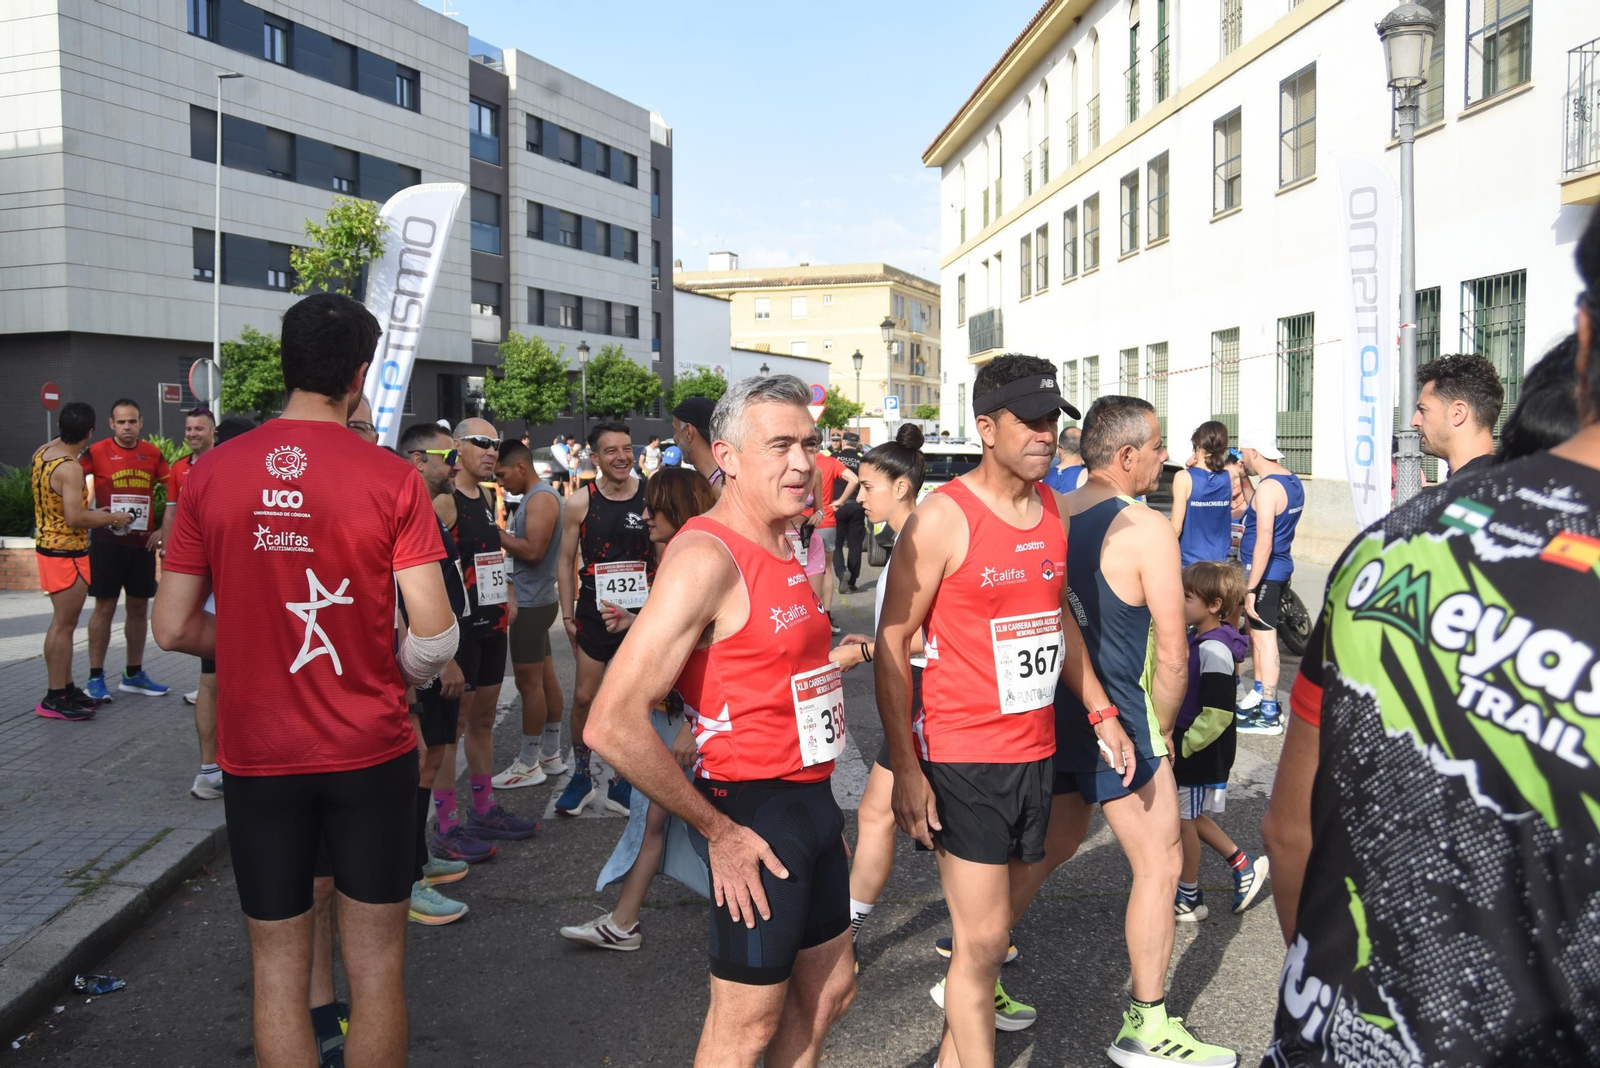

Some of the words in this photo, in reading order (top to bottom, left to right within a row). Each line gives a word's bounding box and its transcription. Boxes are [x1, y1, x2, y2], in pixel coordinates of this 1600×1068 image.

[262, 489, 303, 509] UCO
[266, 531, 309, 547] califas
[492, 570, 503, 587] 55
[993, 568, 1026, 582] califas
[606, 577, 637, 593] 432
[782, 603, 808, 623] califas
[1007, 621, 1032, 632] CARRERA
[1017, 644, 1059, 679] 367
[820, 702, 846, 744] 358
[1456, 673, 1591, 769] TRAIL
